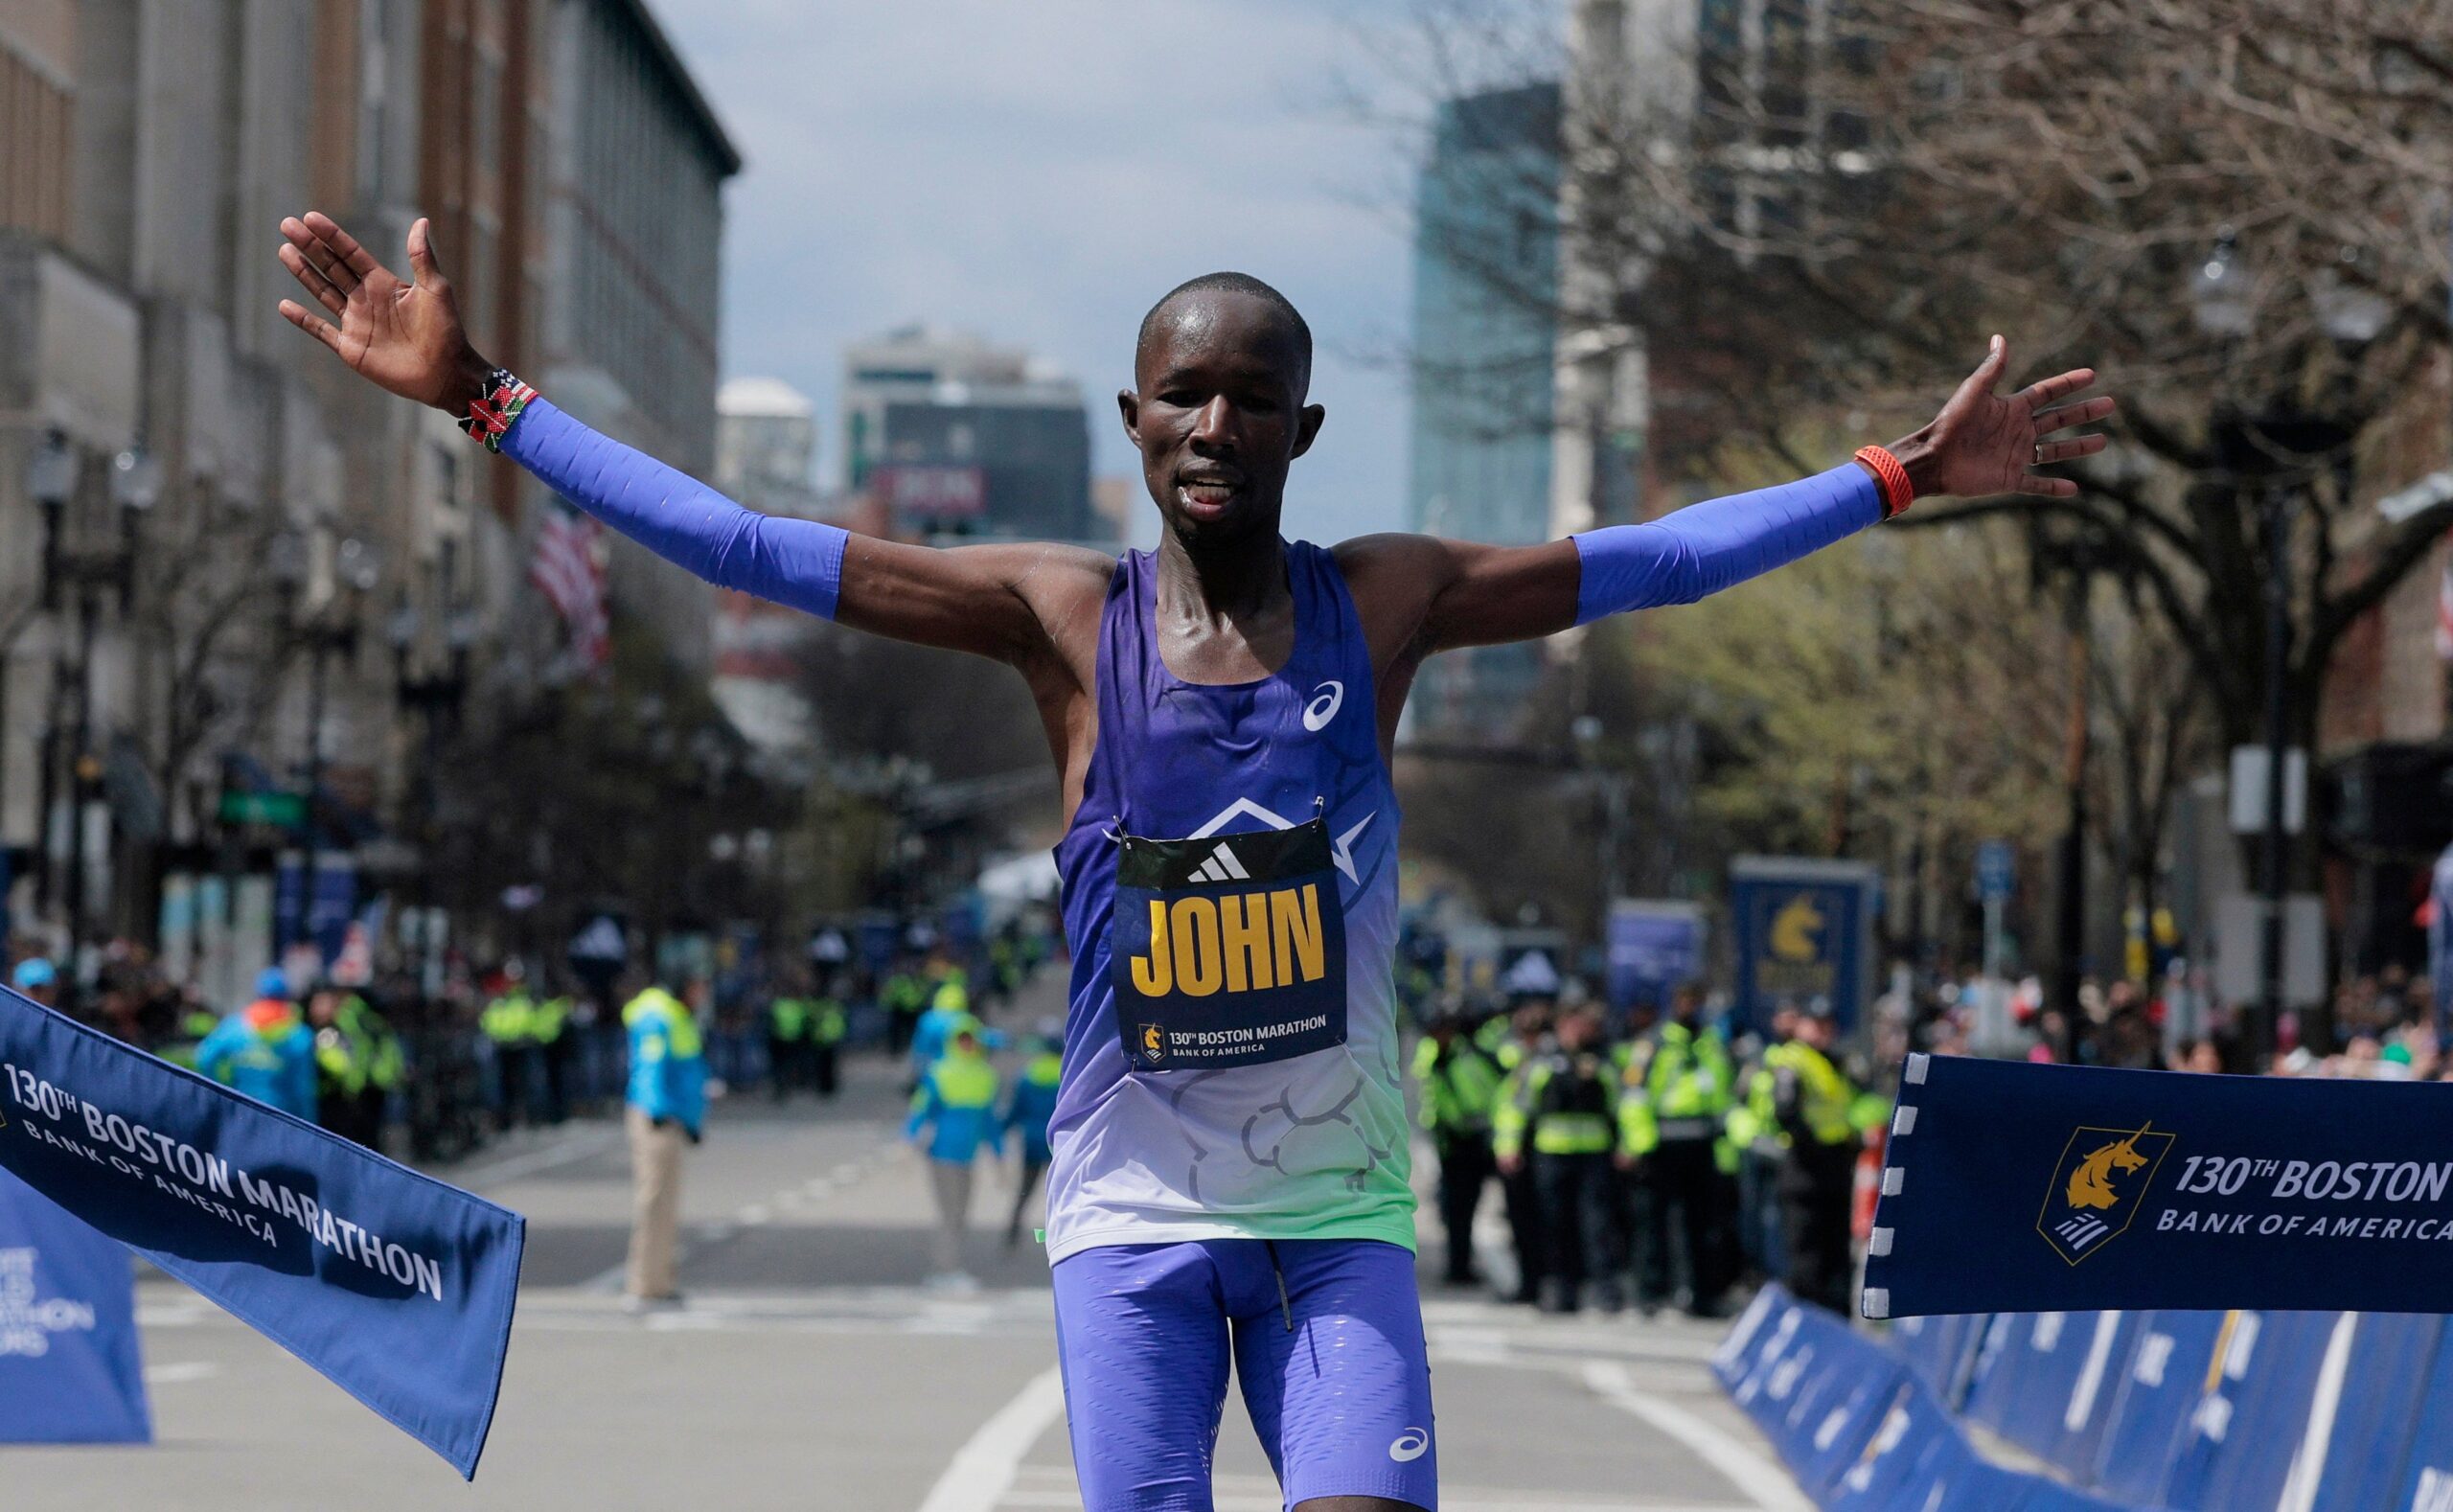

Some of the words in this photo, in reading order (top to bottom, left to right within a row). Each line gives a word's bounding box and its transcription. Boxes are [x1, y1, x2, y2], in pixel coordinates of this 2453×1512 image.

[1131, 883, 1324, 997] JOHN
[1170, 1032, 1197, 1045] 130TH
[1199, 1029, 1253, 1045] BOSTON
[1256, 1014, 1326, 1040] MARATHON
[1173, 1048, 1200, 1057] BANK
[1202, 1048, 1215, 1057] OF
[1217, 1043, 1265, 1056] AMERICA
[4, 1064, 78, 1121] 130TH
[81, 1101, 235, 1199] BOSTON
[238, 1169, 442, 1302] MARATHON
[22, 1119, 105, 1165] BANK
[109, 1156, 144, 1180] OF
[154, 1175, 277, 1249] AMERICA
[2175, 1156, 2281, 1196] 130TH
[2271, 1160, 2453, 1202] BOSTON
[2156, 1209, 2254, 1234] BANK
[2258, 1214, 2304, 1235] OF
[2305, 1217, 2453, 1240] AMERICA
